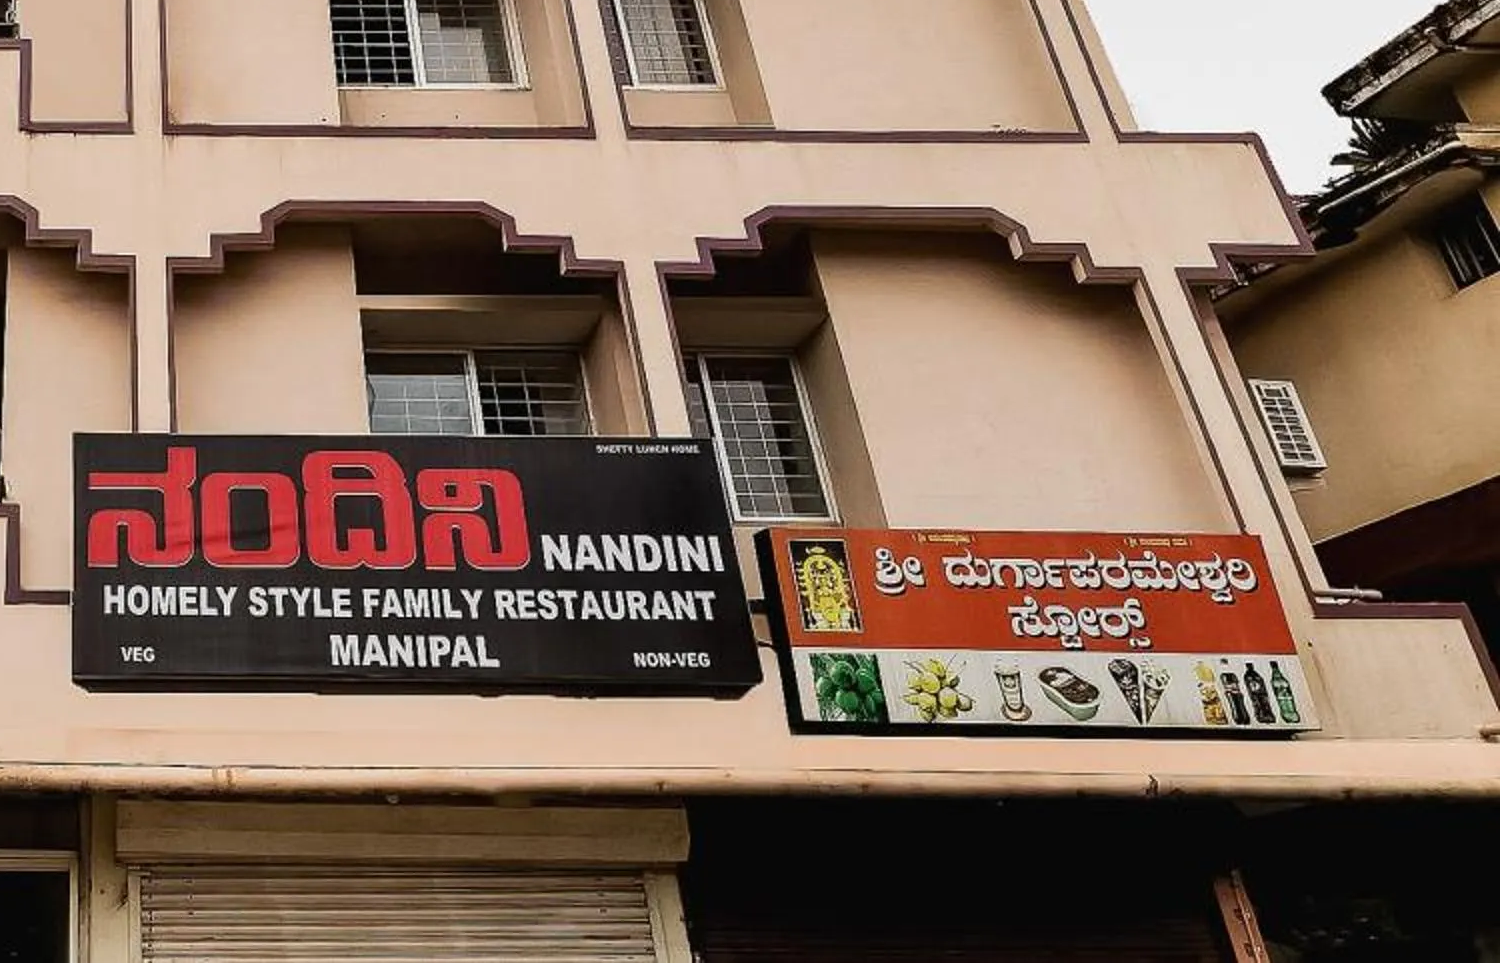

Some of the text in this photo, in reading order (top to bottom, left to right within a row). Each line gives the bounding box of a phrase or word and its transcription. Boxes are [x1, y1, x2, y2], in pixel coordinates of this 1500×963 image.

[87, 446, 531, 571] ನಂದಿನಿ
[541, 534, 726, 572] NANDINI
[875, 547, 1257, 603] ಶ್ರೀ ದುರ್ಗಾಪರಮೇಶ್ವರಿ
[103, 585, 716, 621] HOMELY STYLE FAMILY RESTAURANT
[1007, 595, 1151, 649] ಸ್ಟೋರ್ಸ್
[121, 646, 156, 662] VEG
[330, 635, 500, 668] MANIPAL
[633, 651, 711, 668] NON-VEG
